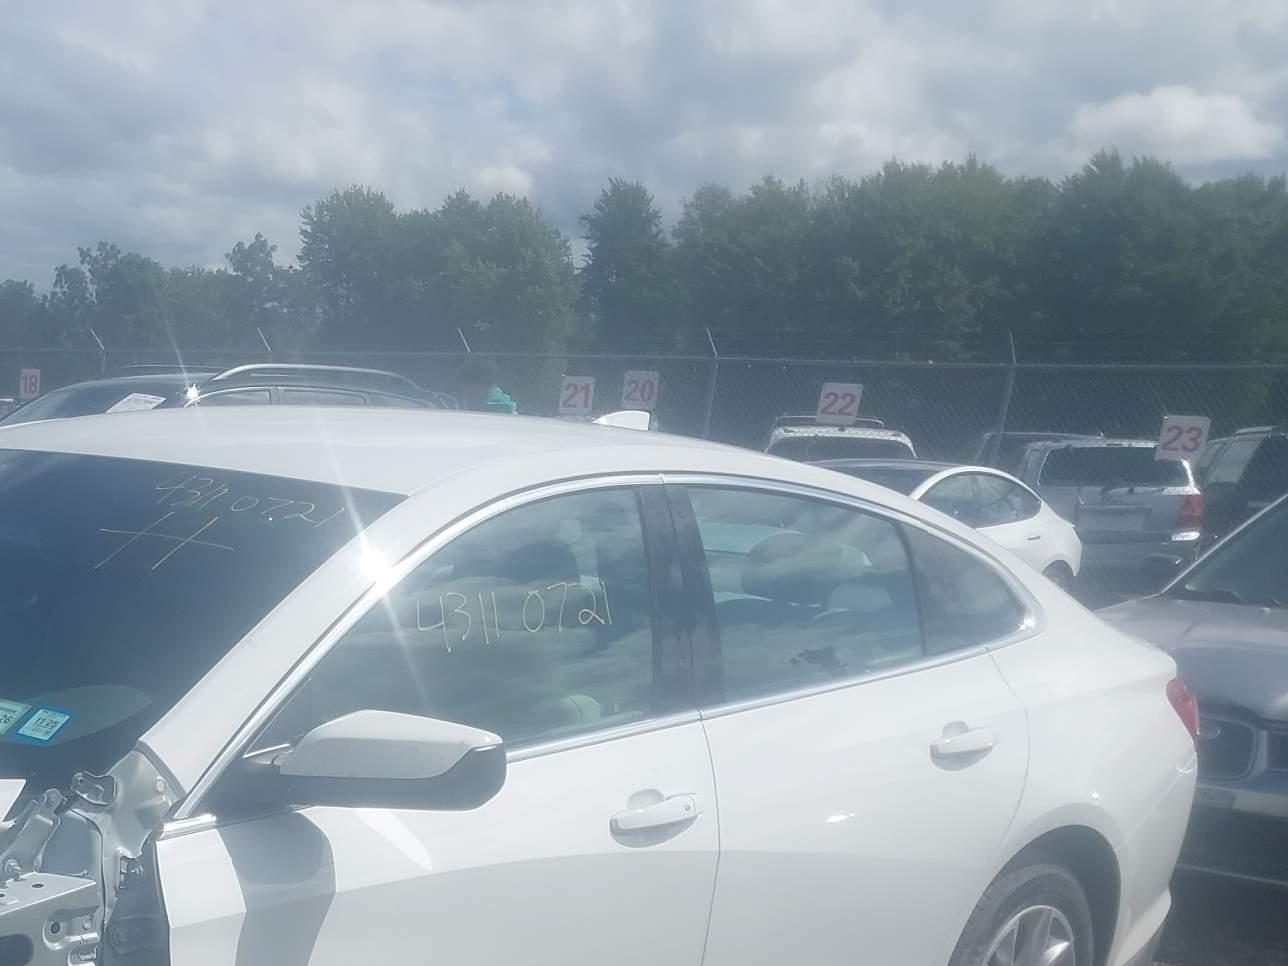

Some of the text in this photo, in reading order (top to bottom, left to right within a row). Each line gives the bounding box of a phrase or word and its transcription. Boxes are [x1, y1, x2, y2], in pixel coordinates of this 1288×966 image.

[22, 374, 38, 395] 18
[561, 383, 591, 409] 21
[624, 381, 654, 401] 20
[820, 392, 857, 417] 22
[1161, 425, 1203, 452] 23
